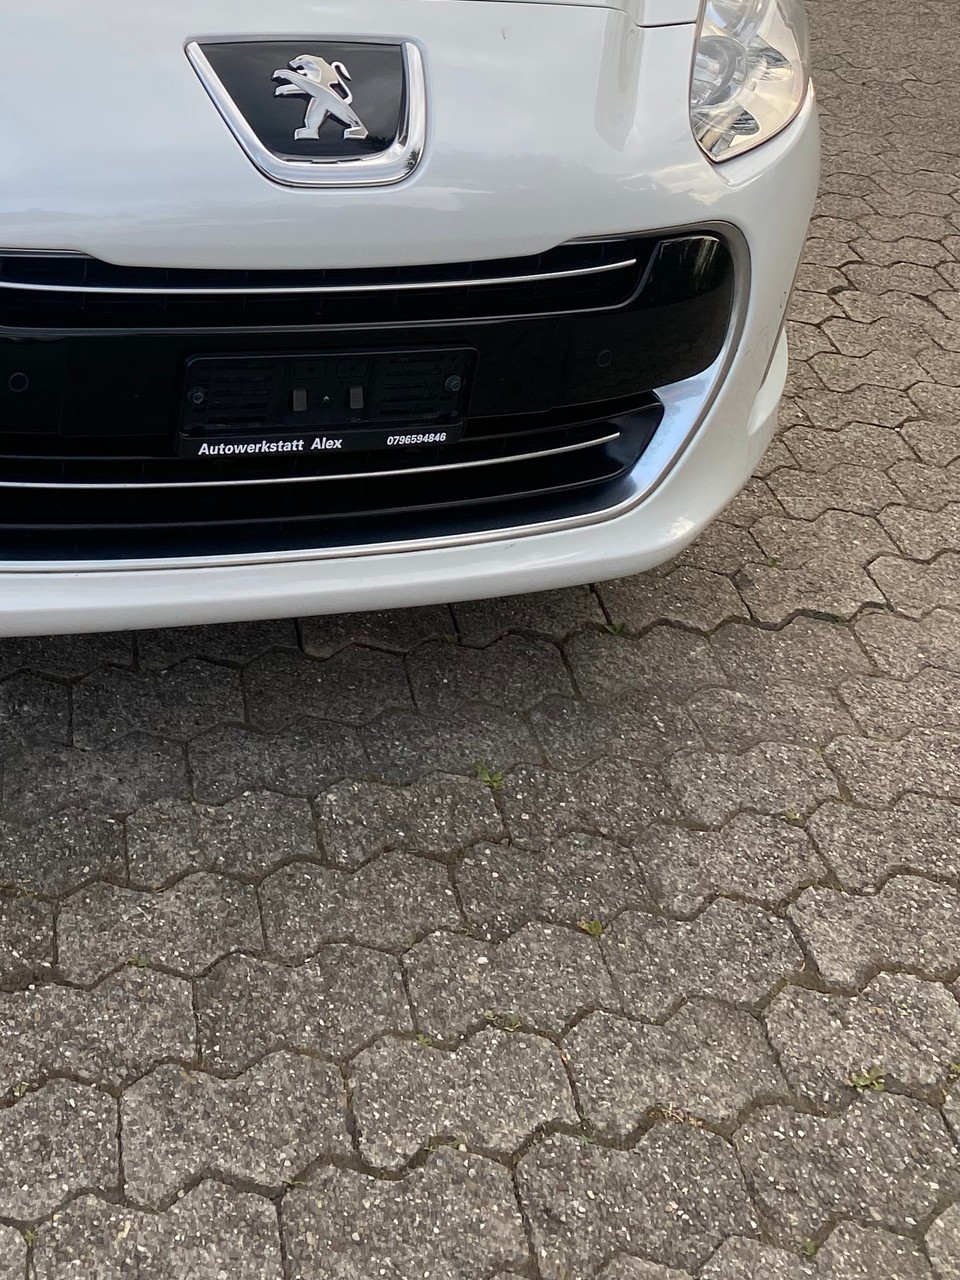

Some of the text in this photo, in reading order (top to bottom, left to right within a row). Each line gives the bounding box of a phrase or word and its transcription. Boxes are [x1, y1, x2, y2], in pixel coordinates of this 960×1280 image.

[198, 437, 342, 455] Autowerkstatt Alex
[386, 432, 447, 446] 0796594846
